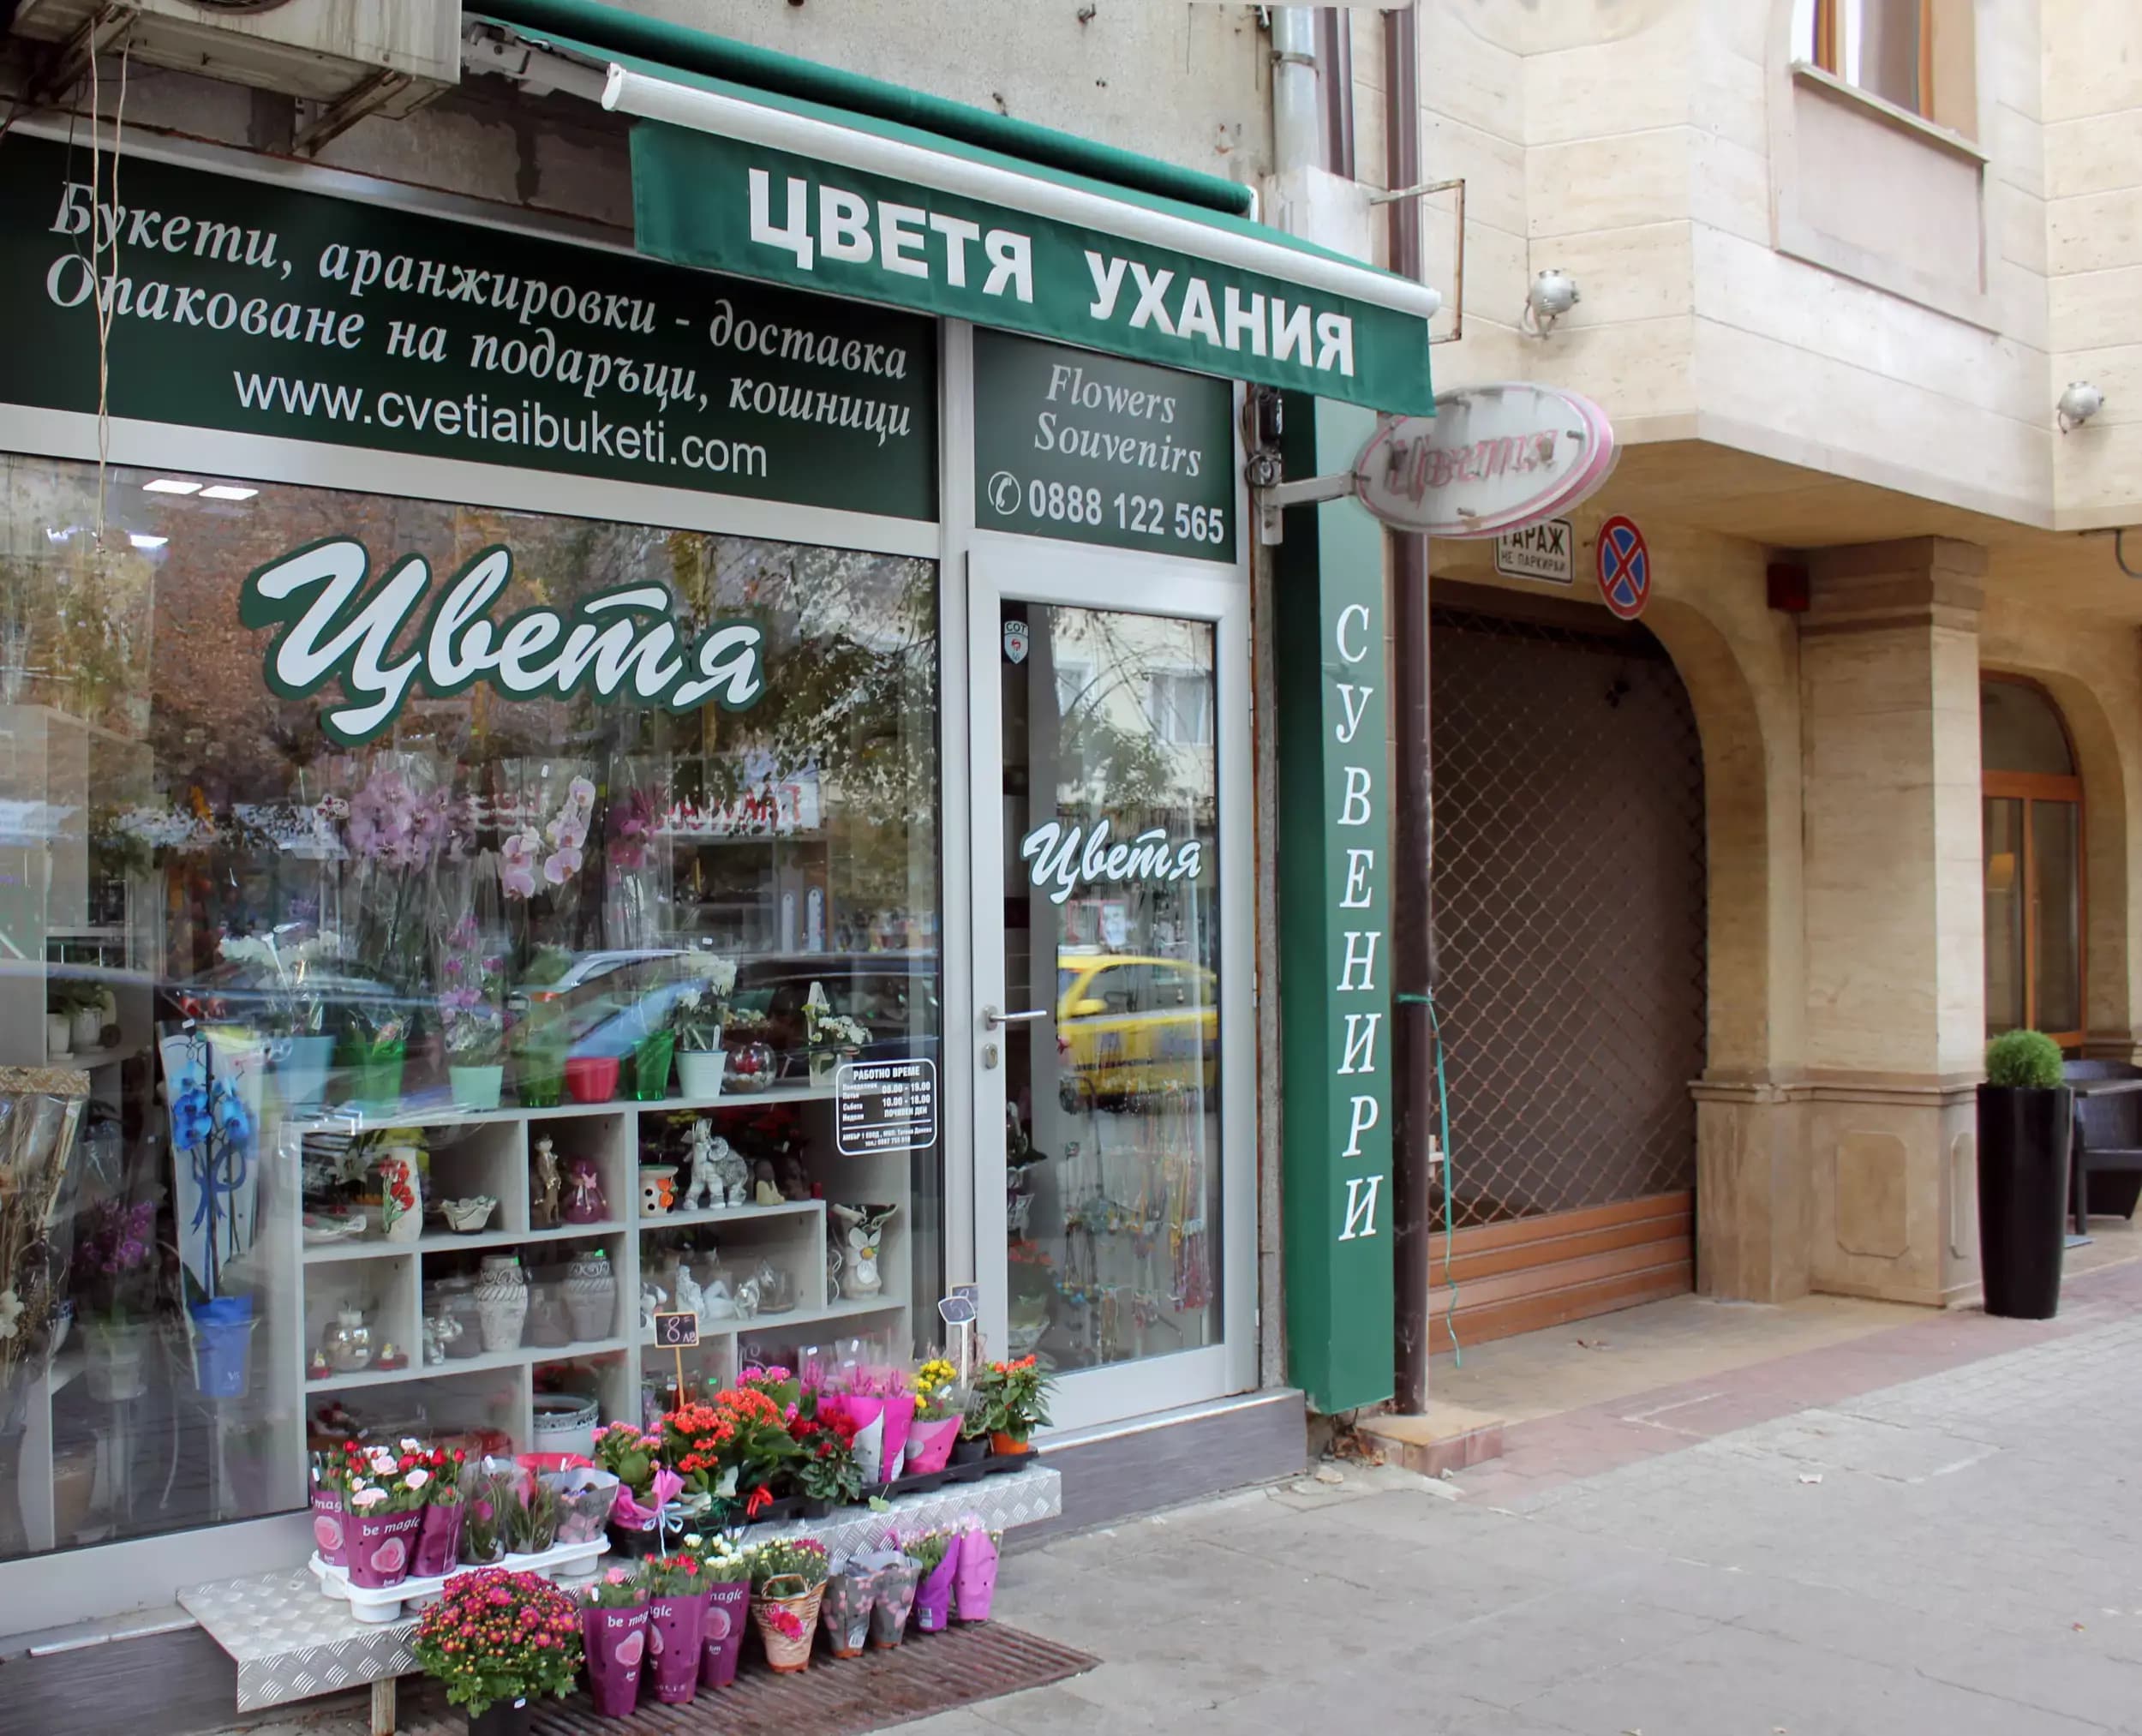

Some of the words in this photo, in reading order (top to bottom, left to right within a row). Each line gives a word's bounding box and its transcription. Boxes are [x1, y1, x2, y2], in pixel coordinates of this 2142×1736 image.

[49, 181, 292, 281] Букети,
[319, 241, 656, 334] аранжировки
[709, 298, 907, 380] доставка
[748, 168, 1034, 303] ЦВЕТЯ
[1084, 249, 1355, 378] УХАНИЯ
[46, 254, 366, 350] Опаковане
[386, 320, 447, 363] на
[470, 327, 709, 413] подаръци,
[729, 374, 912, 448] кошници
[232, 370, 768, 478] www.cvetiaibuketi.com
[1044, 363, 1177, 424] Flowers
[1033, 411, 1202, 477] Souvenirs
[1028, 479, 1103, 526] 0888
[1113, 493, 1166, 536] 122
[1174, 503, 1225, 545] 565
[253, 540, 764, 739] Цветя
[1021, 817, 1203, 905] Цветя
[1334, 602, 1385, 1242] СУВЕНИРИ
[853, 1068, 891, 1081] РАБОТНО
[892, 1065, 921, 1078] ВРЕМЕ
[882, 1096, 903, 1107] 10.00
[910, 1081, 931, 1092] 19.00
[314, 1499, 343, 1513] mag
[362, 1524, 380, 1536] be
[383, 1516, 421, 1534] magic
[607, 1615, 624, 1628] be
[628, 1609, 649, 1627] mag
